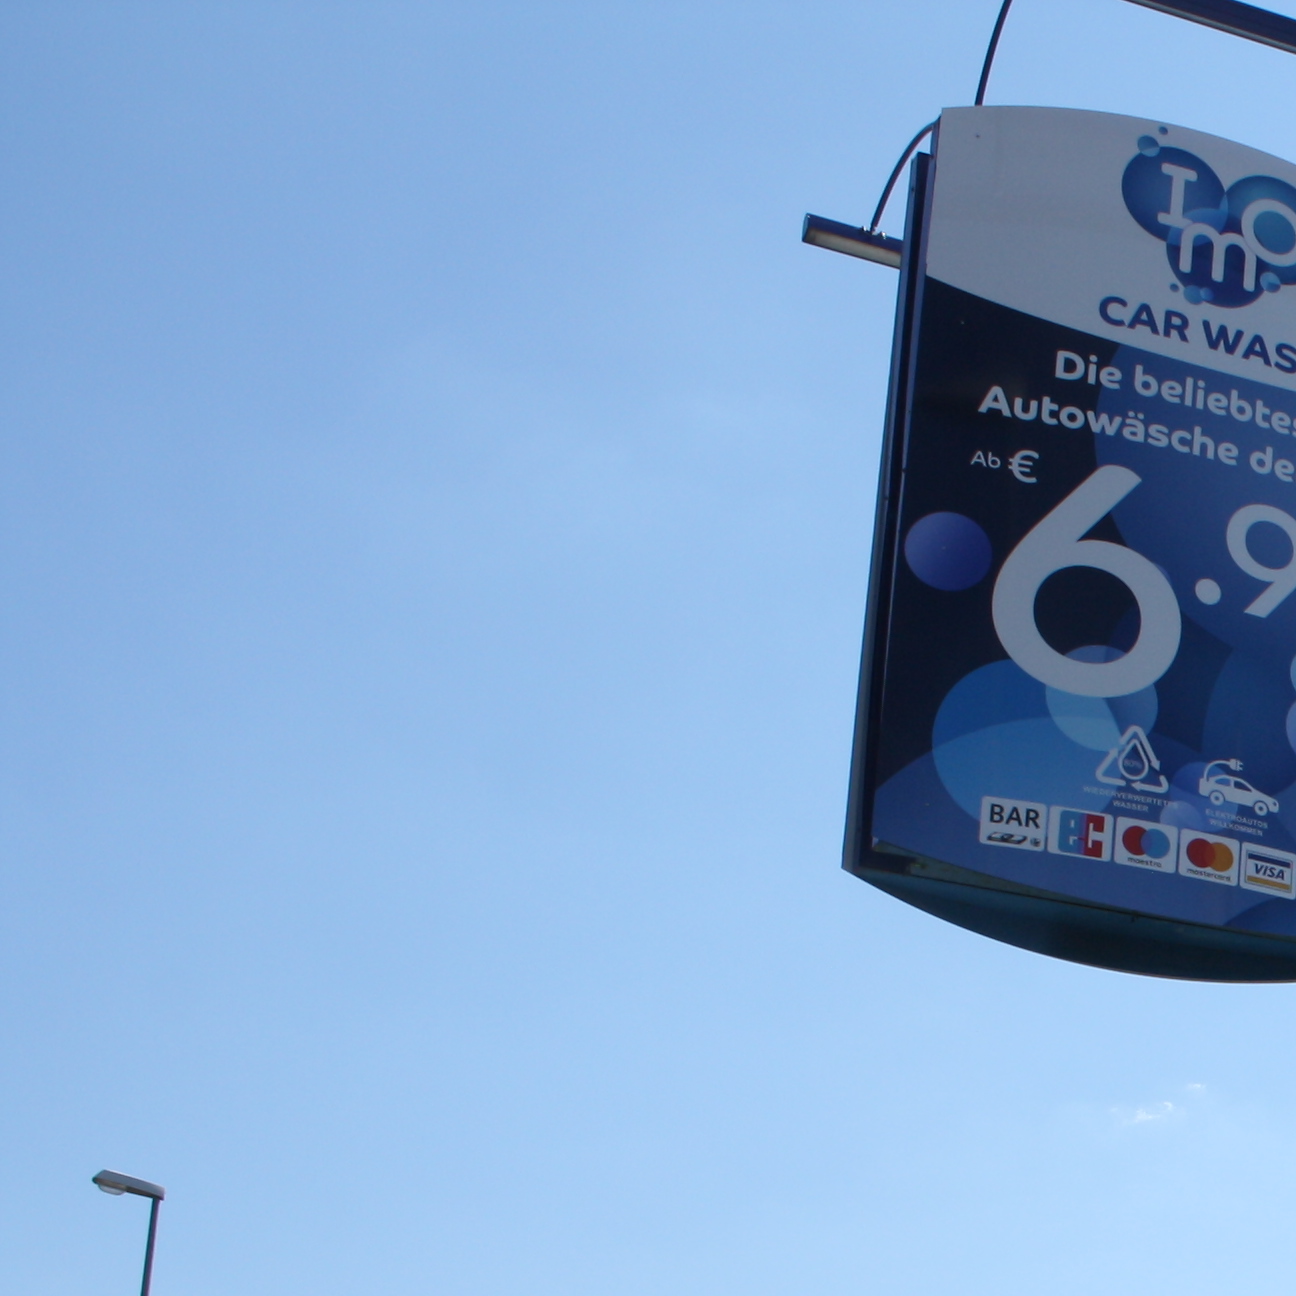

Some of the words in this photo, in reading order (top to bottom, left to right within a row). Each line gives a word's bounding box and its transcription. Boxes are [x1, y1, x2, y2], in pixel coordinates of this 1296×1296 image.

[1099, 297, 1190, 342] CAR
[1055, 350, 1123, 390] Die
[978, 385, 1240, 466] Autowäsche
[970, 450, 1001, 470] Ab
[1008, 449, 1040, 484] €
[989, 803, 1040, 829] BAR
[1205, 808, 1268, 829] ELEKTROAUTOS
[1209, 819, 1263, 837] WILLKOMMEN
[1127, 855, 1162, 869] maestro
[1253, 863, 1287, 881] VISA
[1186, 868, 1232, 883] mastercard
